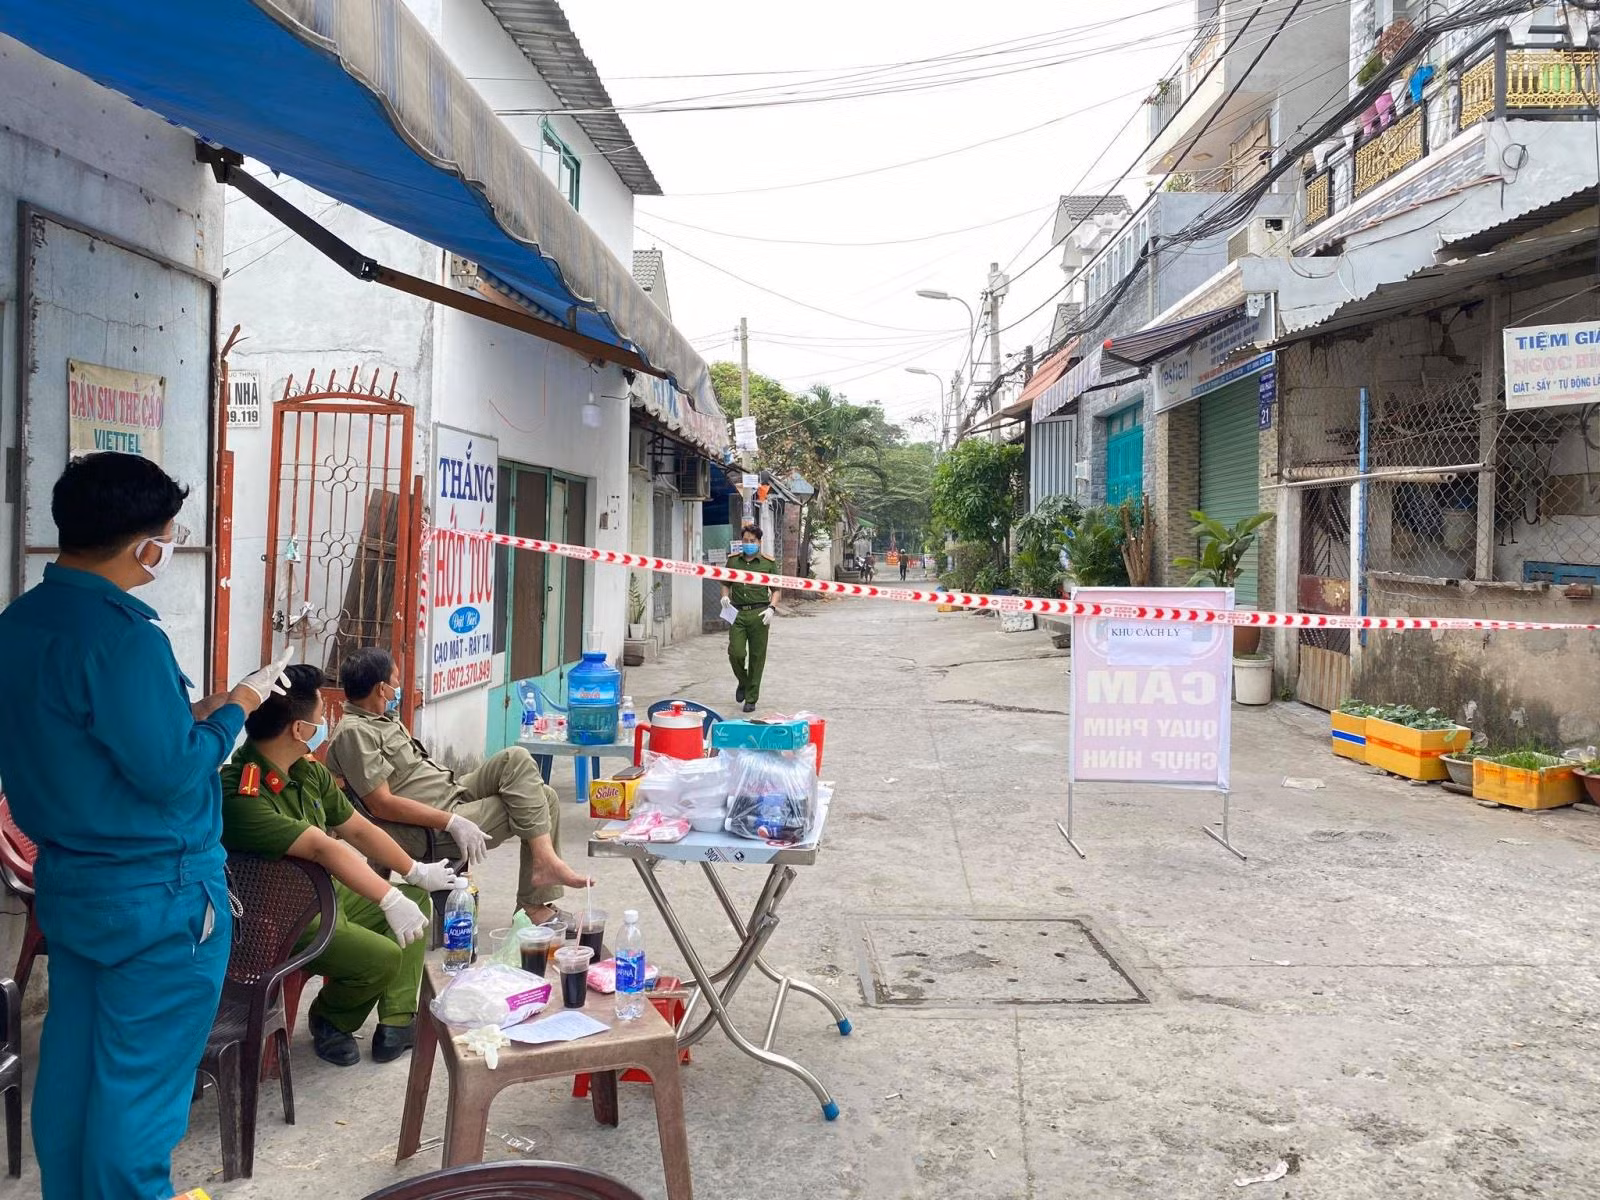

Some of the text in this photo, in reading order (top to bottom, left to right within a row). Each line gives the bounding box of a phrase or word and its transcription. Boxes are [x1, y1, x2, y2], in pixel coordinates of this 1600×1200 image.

[1515, 332, 1569, 351] TIỆM
[1513, 355, 1571, 375] NGỌC
[70, 372, 97, 419] BÁN
[97, 386, 117, 424] SIM
[235, 376, 259, 405] NHÀ
[1261, 407, 1269, 424] 21
[94, 428, 141, 453] VIETTEL
[439, 439, 494, 503] THẮNG
[469, 507, 494, 604] TÓC
[1111, 628, 1134, 637] KHU
[434, 641, 448, 667] CẠO
[449, 636, 463, 665] MẶT
[469, 631, 481, 656] RÁY
